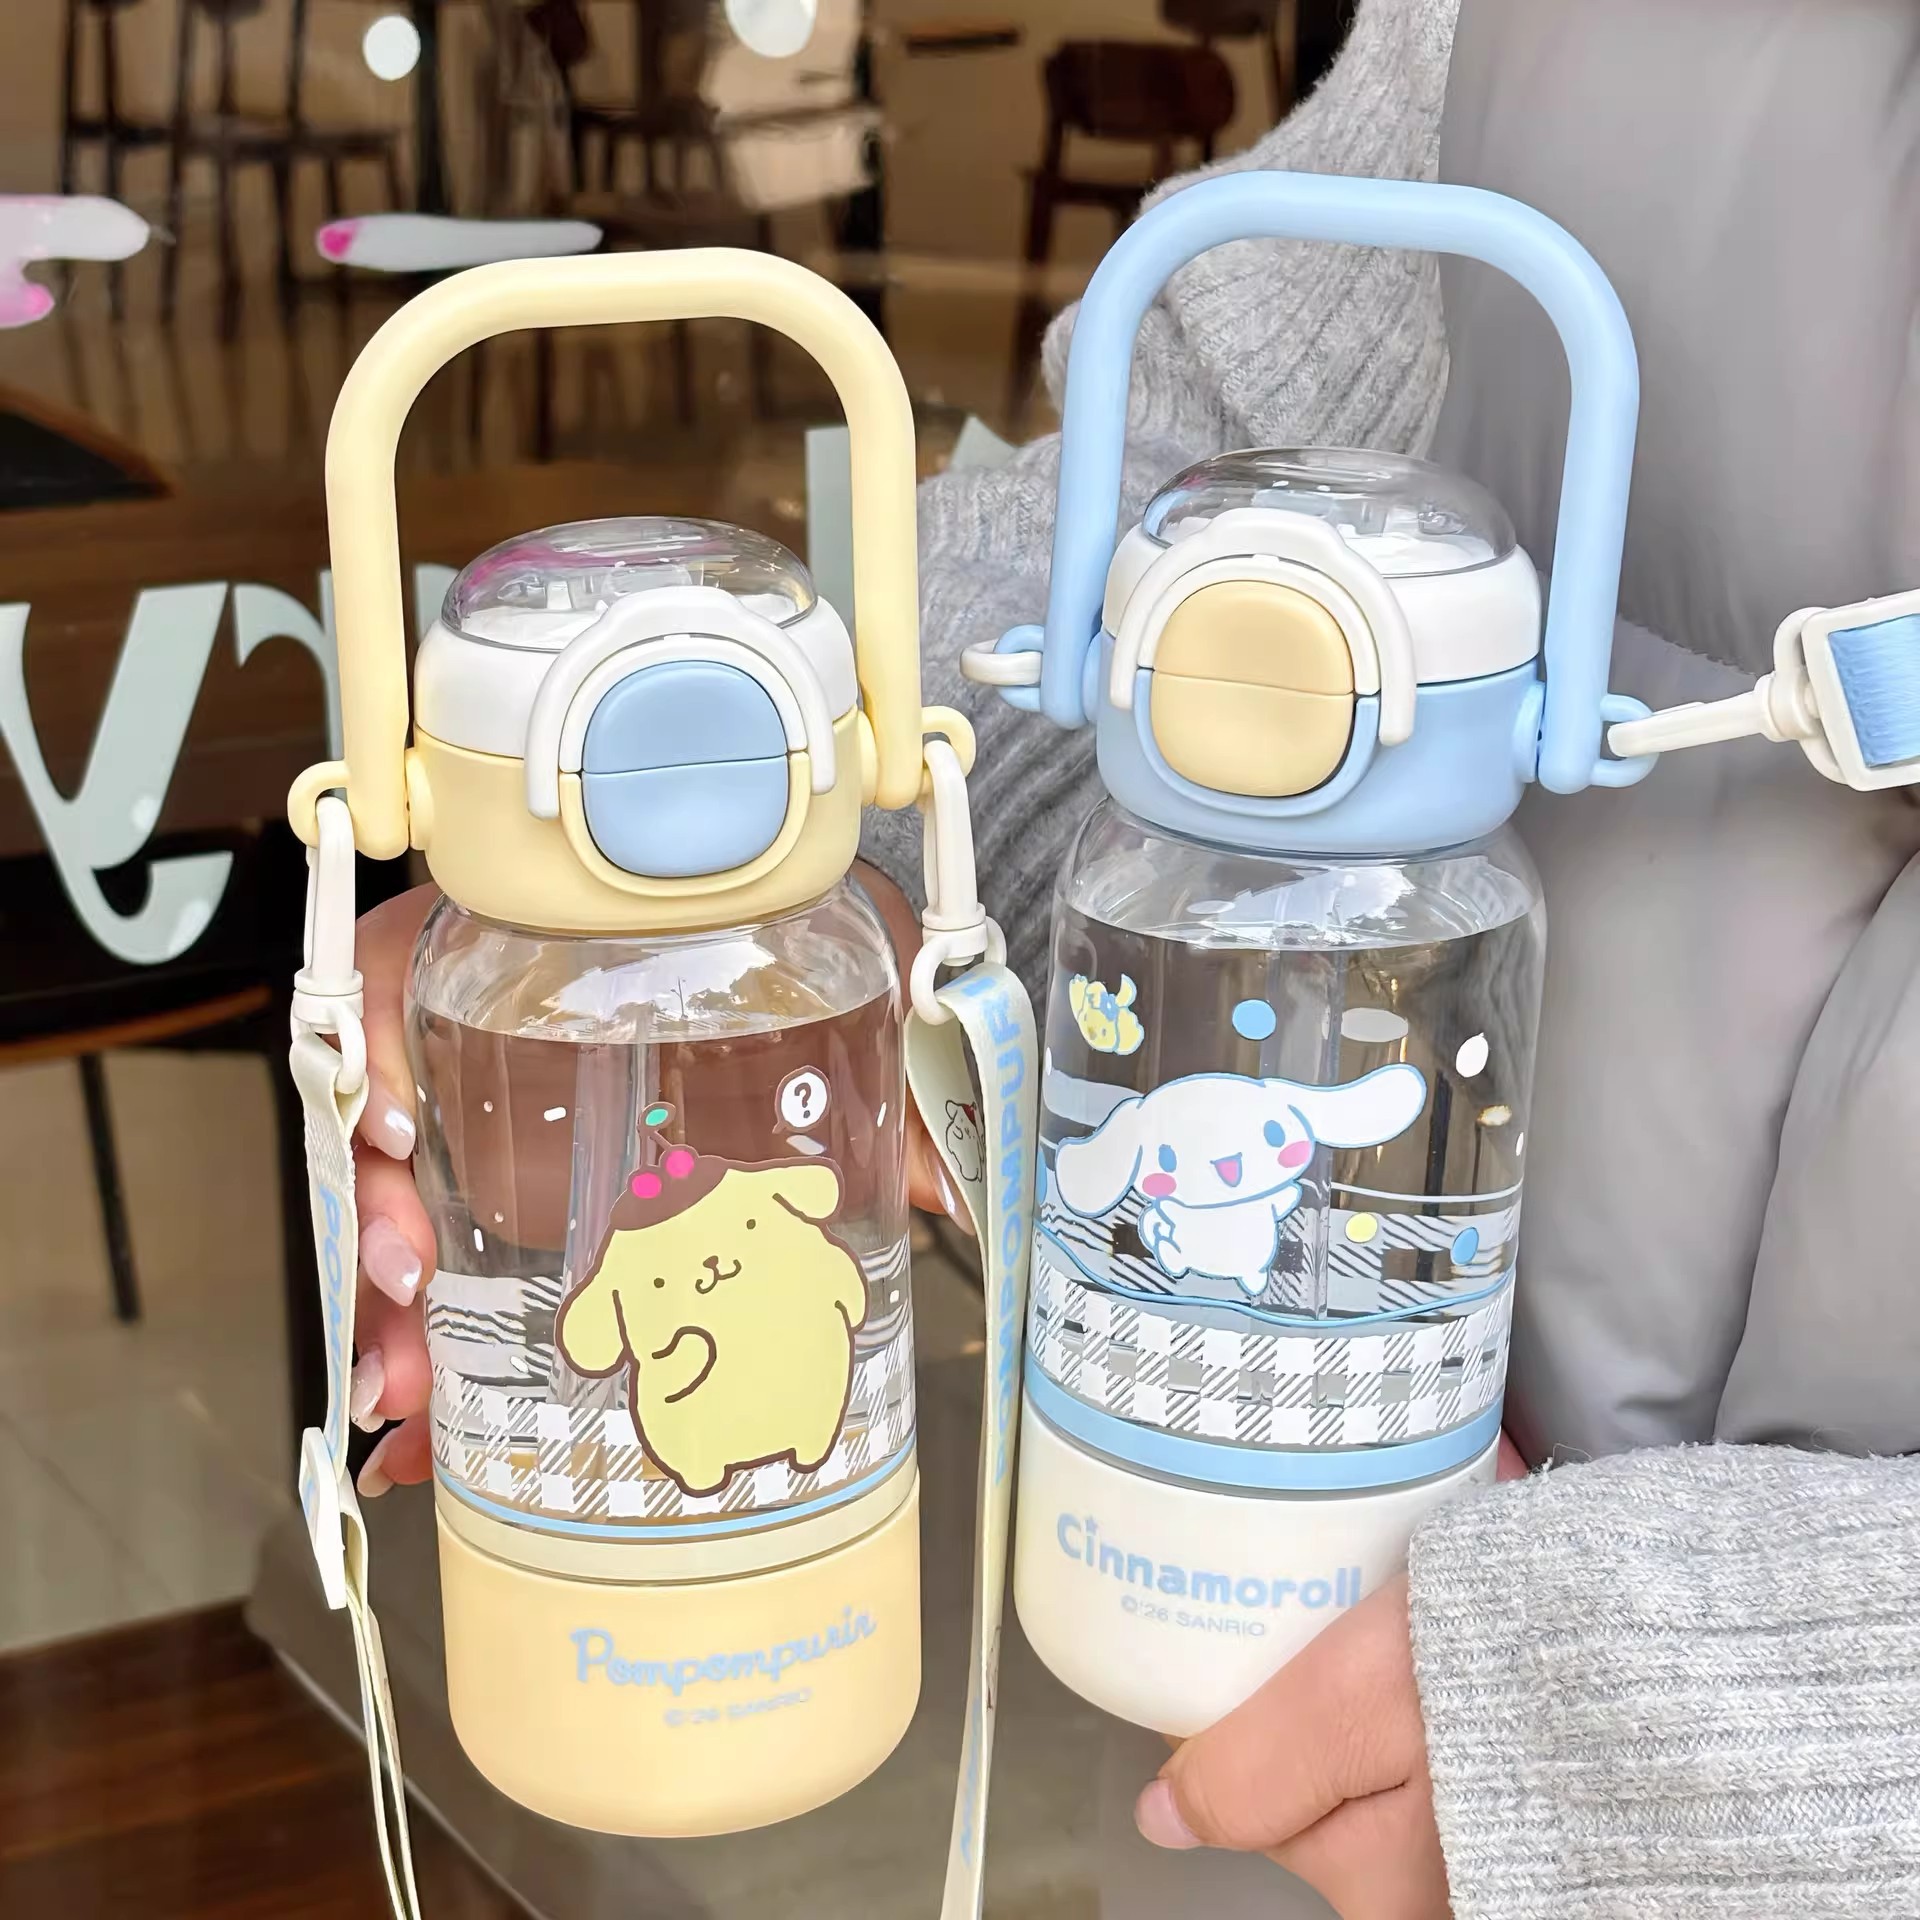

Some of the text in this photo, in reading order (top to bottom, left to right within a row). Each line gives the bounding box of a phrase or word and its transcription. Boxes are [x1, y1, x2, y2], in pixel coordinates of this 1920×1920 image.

[794, 1082, 812, 1119] ?
[1056, 1512, 1361, 1609] Cinnamoroll
[569, 1602, 877, 1697] Pompompurin
[1176, 1611, 1266, 1637] SANRIO
